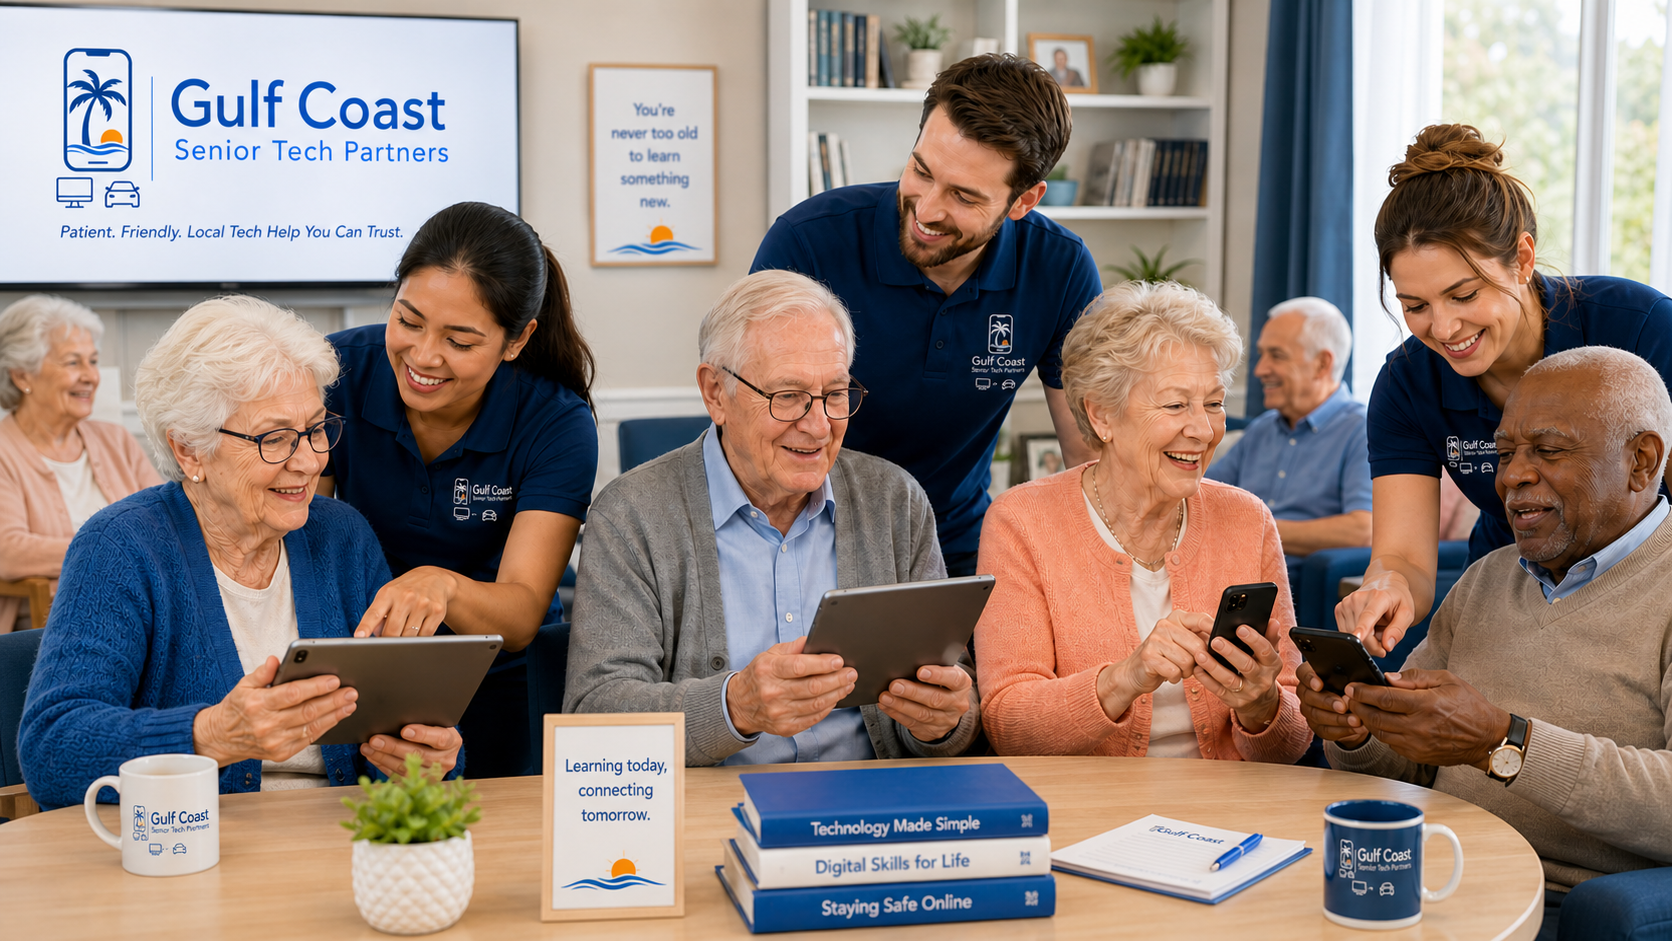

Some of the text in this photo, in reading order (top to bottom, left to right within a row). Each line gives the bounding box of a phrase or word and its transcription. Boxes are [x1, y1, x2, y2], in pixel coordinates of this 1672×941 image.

[171, 78, 446, 131] Gulf Coast
[633, 102, 675, 117] You're
[611, 125, 698, 140] never too old
[174, 138, 449, 163] Senior Tech Partners
[629, 147, 681, 163] to learn
[620, 170, 690, 189] something
[639, 197, 671, 208] new.
[60, 224, 404, 242] Patient. Friendly. Local Tech Help You Can Trust.
[971, 355, 1026, 367] Gulf Coast
[1462, 440, 1478, 450] Gulf
[472, 484, 513, 496] Gulf Coast
[565, 757, 667, 776] Learning today,
[578, 782, 654, 800] connecting
[150, 808, 210, 826] Gulf Coast
[581, 809, 650, 822] tomorrow.
[810, 815, 981, 838] Technology Made Simple
[1357, 847, 1412, 862] Gulf Coast
[815, 852, 970, 878] Digital Skills for Life
[821, 894, 973, 919] Staying Safe Online
